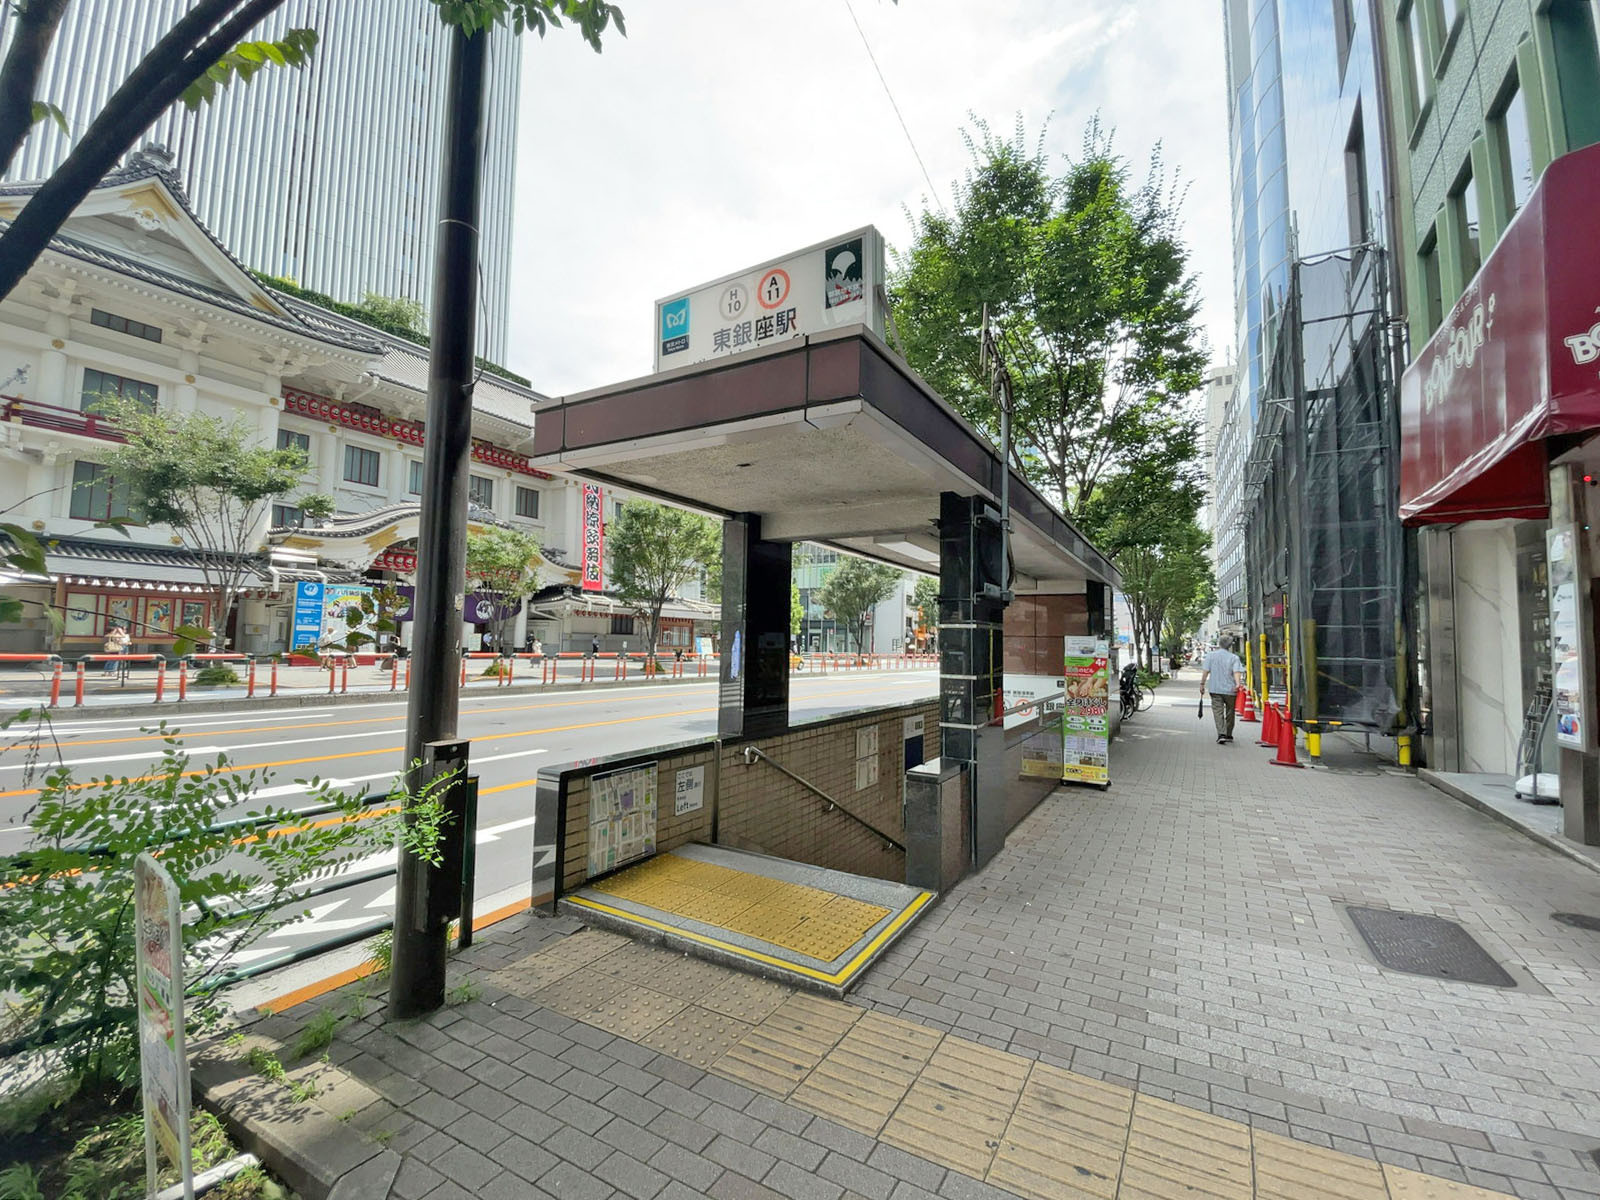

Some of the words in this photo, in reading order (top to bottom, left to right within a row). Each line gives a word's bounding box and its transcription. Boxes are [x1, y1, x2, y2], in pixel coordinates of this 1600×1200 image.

[769, 277, 778, 288] A
[730, 289, 738, 300] H
[767, 287, 781, 301] 11
[727, 300, 741, 314] 10
[713, 307, 797, 353] 東銀座駅
[1080, 706, 1107, 717] 2980
